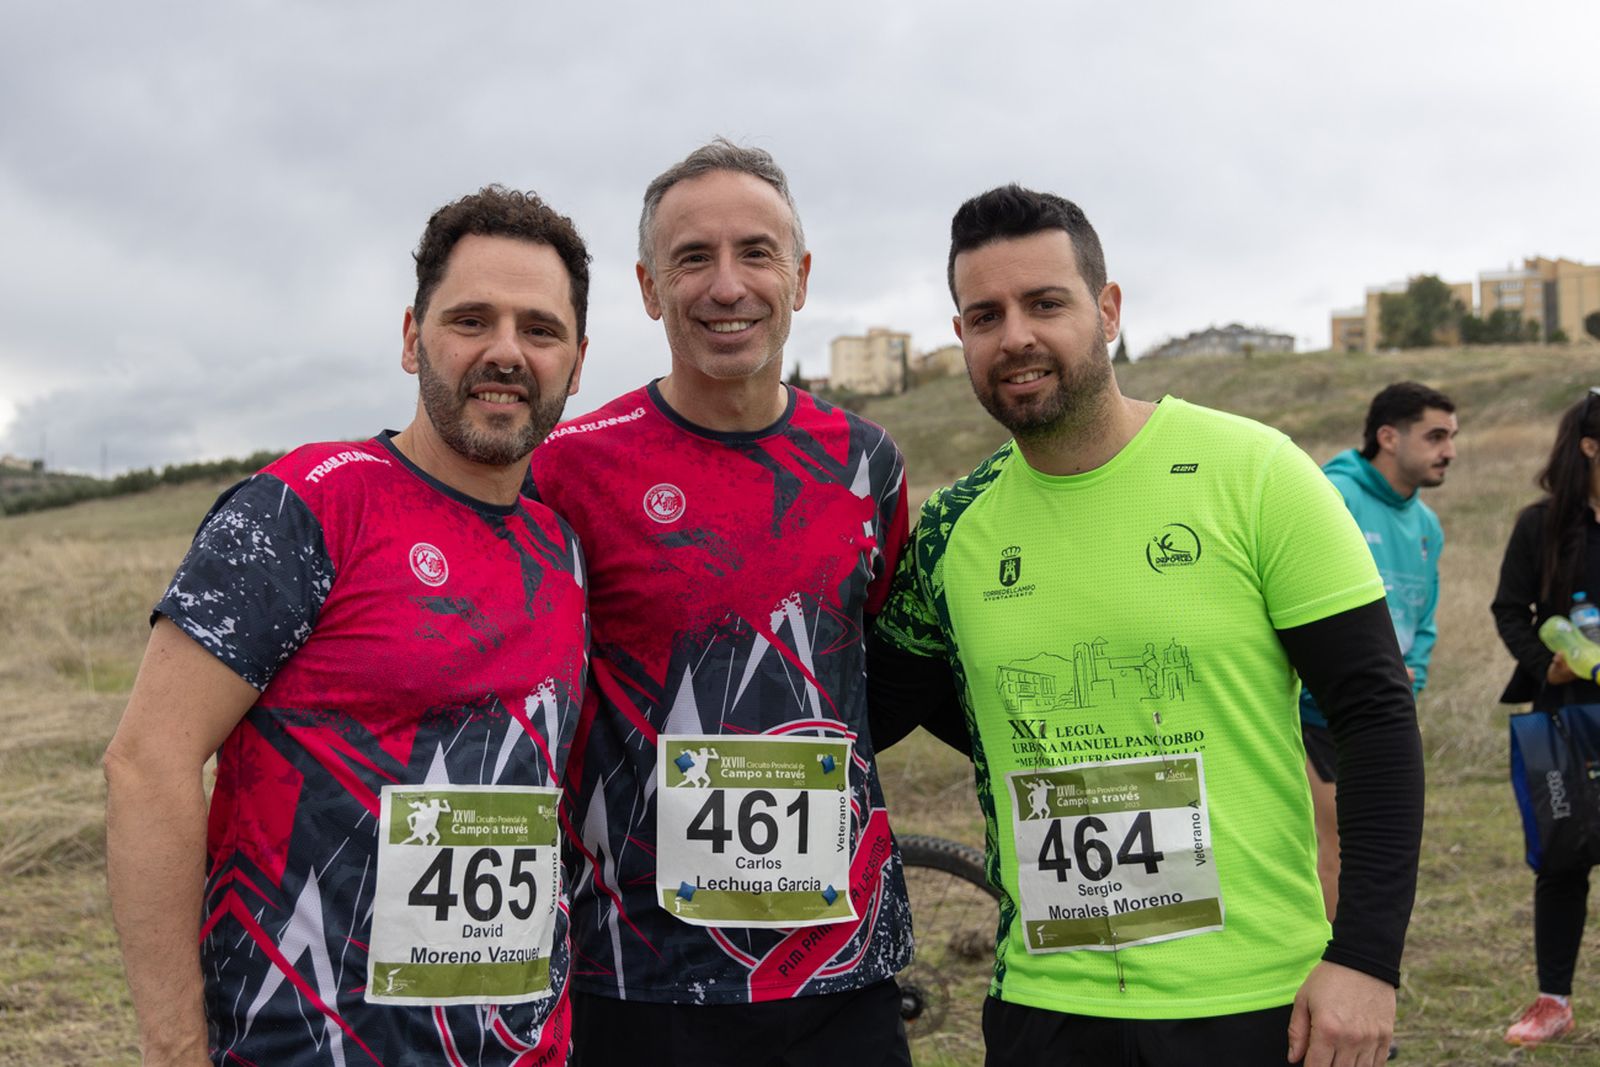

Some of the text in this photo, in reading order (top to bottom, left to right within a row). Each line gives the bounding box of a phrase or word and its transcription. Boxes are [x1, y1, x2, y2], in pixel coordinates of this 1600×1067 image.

[1056, 723, 1105, 738] LEGUA
[1058, 736, 1123, 752] MANUEL
[1126, 729, 1205, 748] PANCORBO
[721, 756, 746, 769] XXVIII
[771, 761, 798, 769] Provincial
[721, 769, 806, 780] Campo a través
[1057, 784, 1076, 798] XXVIII
[1097, 785, 1128, 795] Provincial
[1129, 784, 1138, 792] de
[1057, 793, 1140, 808] Campo a través
[452, 810, 476, 823] XXVIII
[476, 815, 497, 823] Circuito
[498, 815, 520, 823] Provincial
[686, 789, 809, 855] 461
[836, 783, 847, 853] Veterano C
[451, 824, 529, 837] Campo a través
[1188, 799, 1206, 867] Veterano A
[1038, 811, 1165, 883] 464
[735, 856, 782, 870] Carlos
[408, 848, 537, 922] 465
[548, 852, 558, 915] Veterano
[696, 876, 822, 895] Lechuga Garcia
[1078, 880, 1123, 898] Sergio
[1049, 892, 1183, 920] Morales Moreno
[462, 924, 503, 939] David
[410, 947, 481, 964] Moreno
[777, 950, 805, 977] PIM
